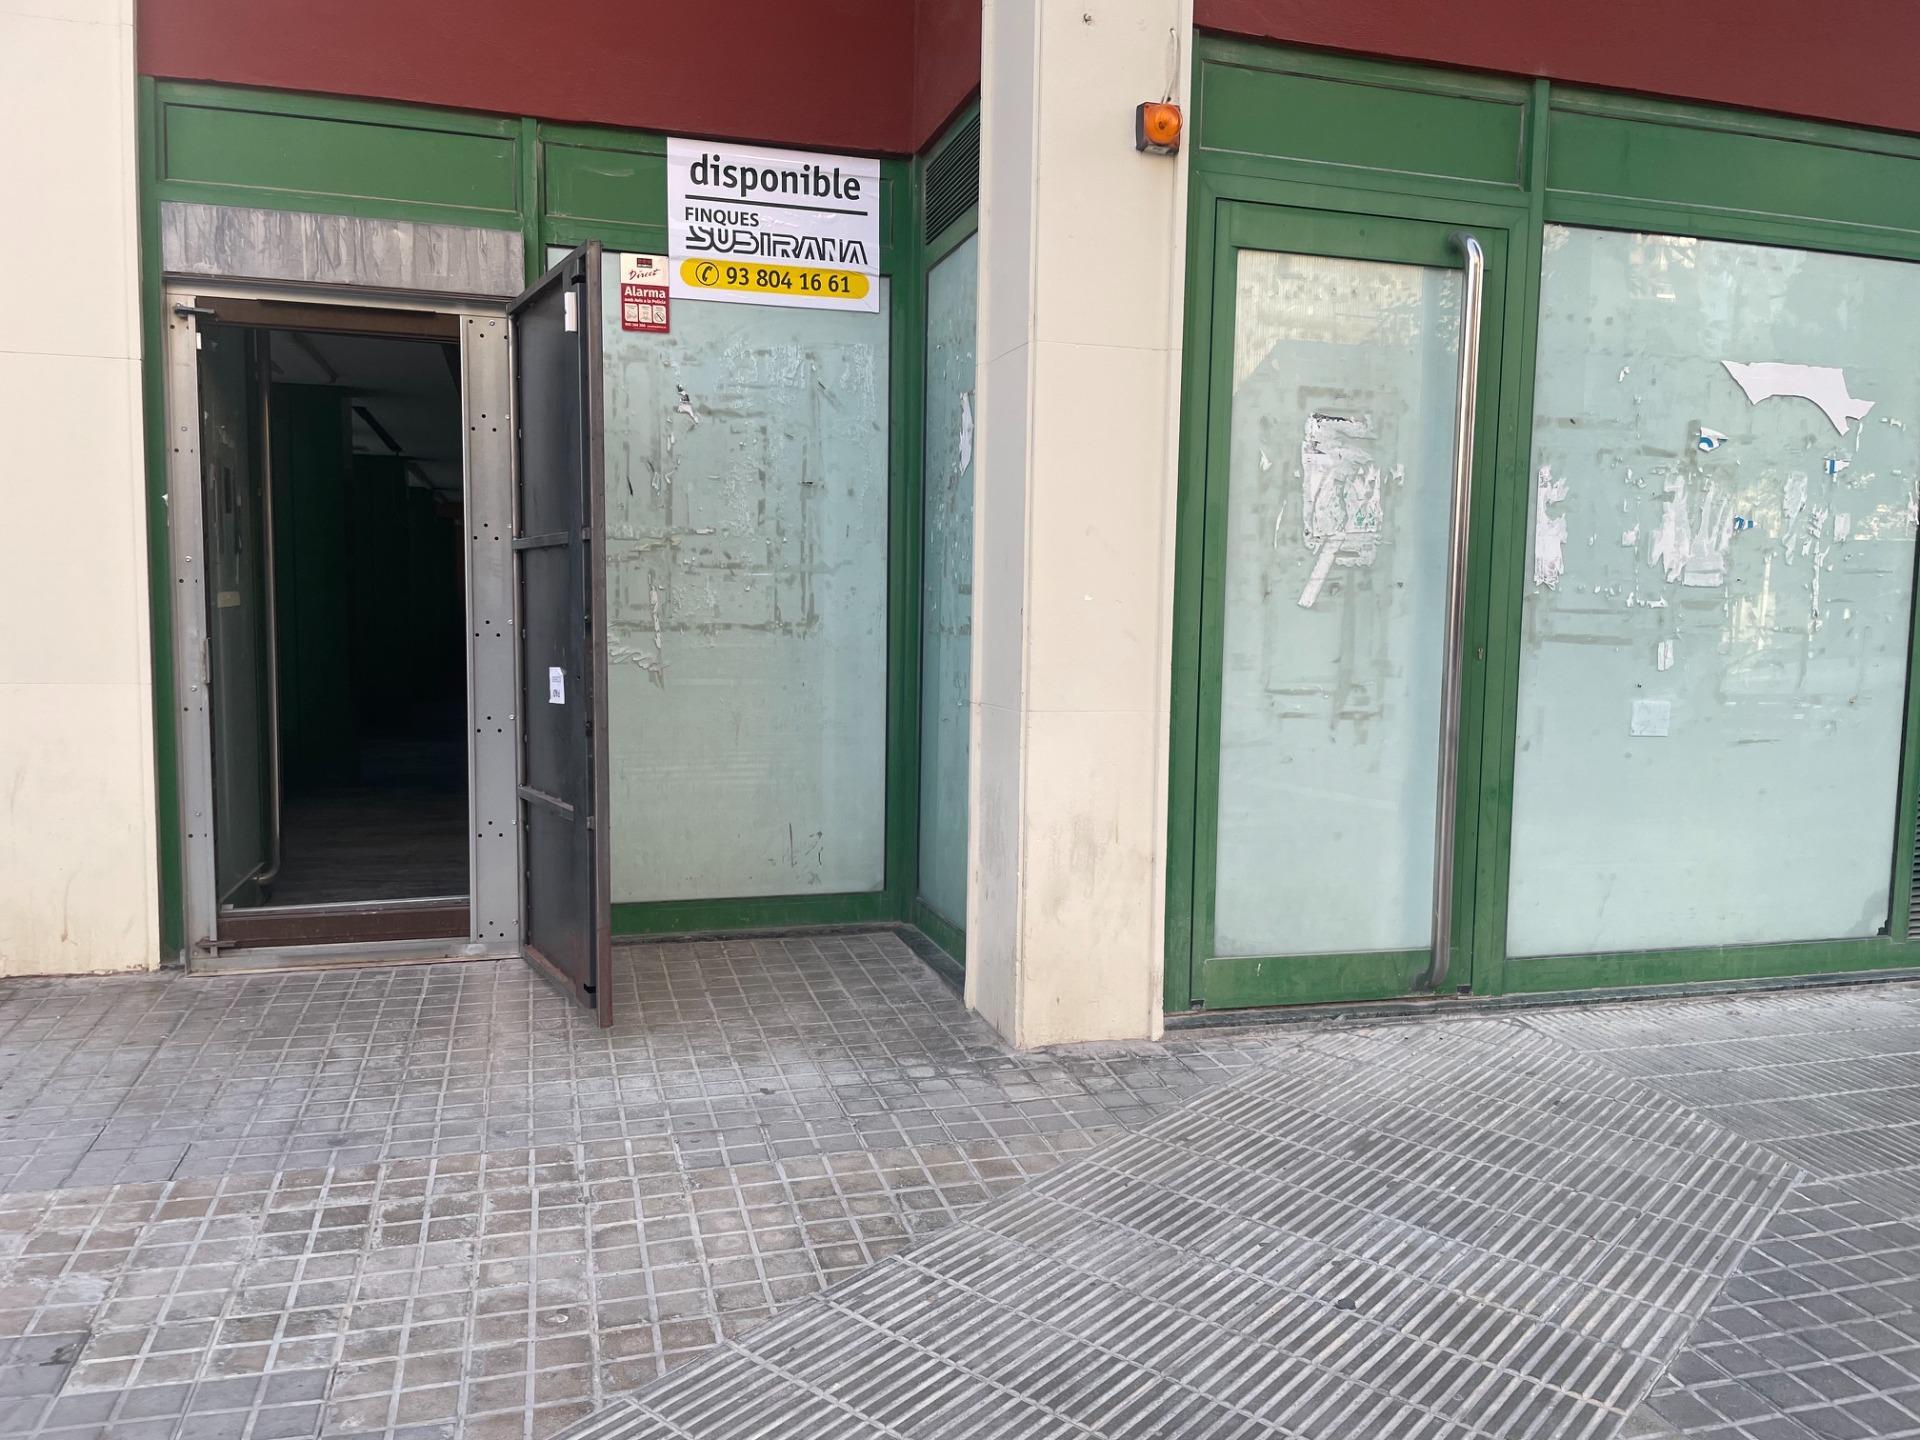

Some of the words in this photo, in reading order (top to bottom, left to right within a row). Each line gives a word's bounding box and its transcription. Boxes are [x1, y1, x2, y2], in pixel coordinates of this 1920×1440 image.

[690, 153, 861, 201] disponible
[685, 206, 759, 227] FINQUES
[685, 225, 868, 265] SUBIRANA
[624, 286, 666, 299] Alarma
[726, 267, 750, 285] 93
[756, 271, 792, 289] 804
[800, 273, 822, 291] 16
[828, 275, 850, 293] 61
